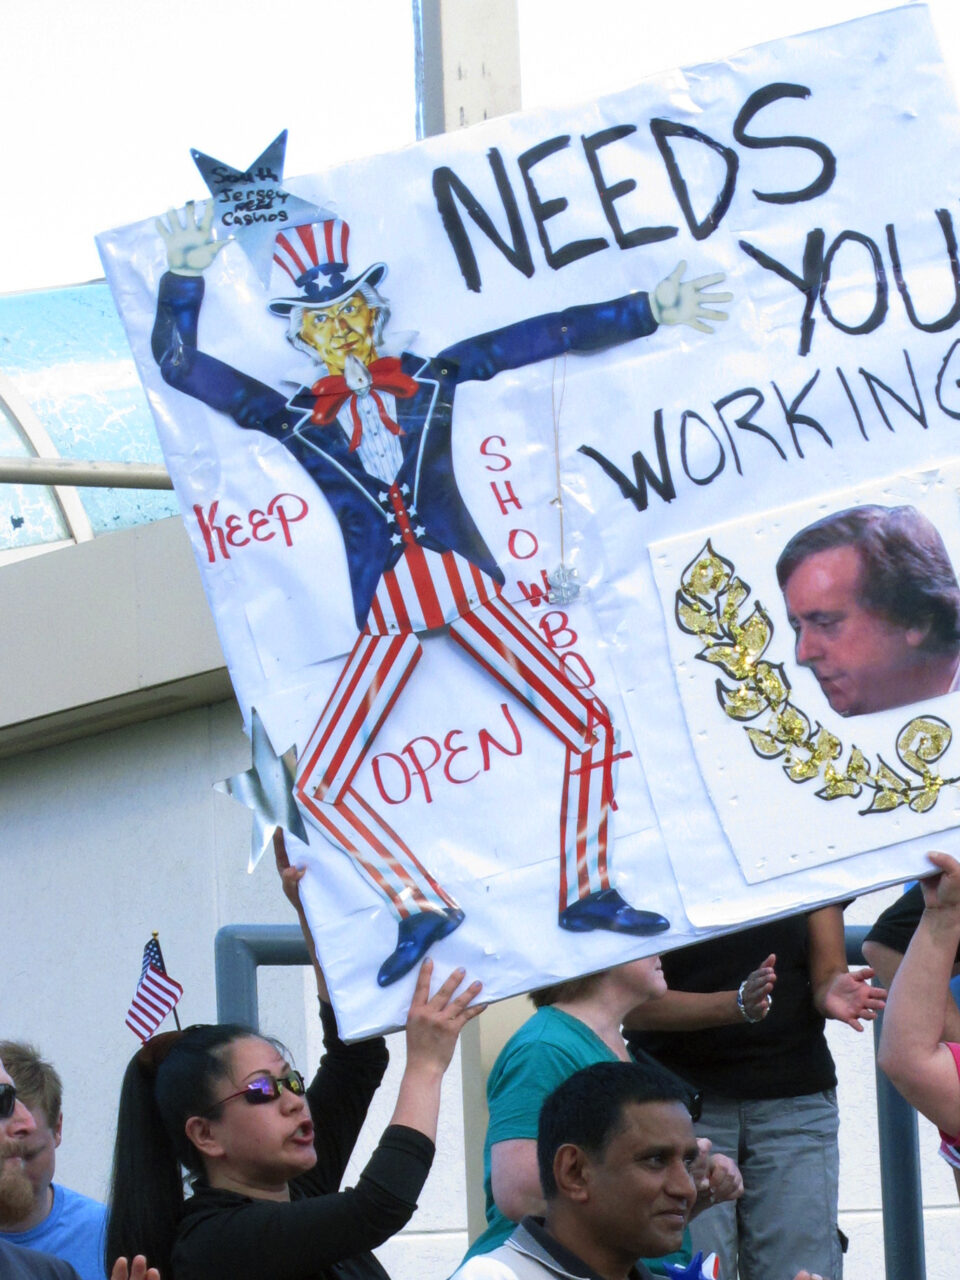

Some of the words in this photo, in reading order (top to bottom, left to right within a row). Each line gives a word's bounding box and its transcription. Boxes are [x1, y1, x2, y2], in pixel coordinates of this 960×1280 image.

[219, 189, 290, 204] Jersey
[432, 82, 836, 292] NEEDS
[371, 703, 523, 805] OPEN
